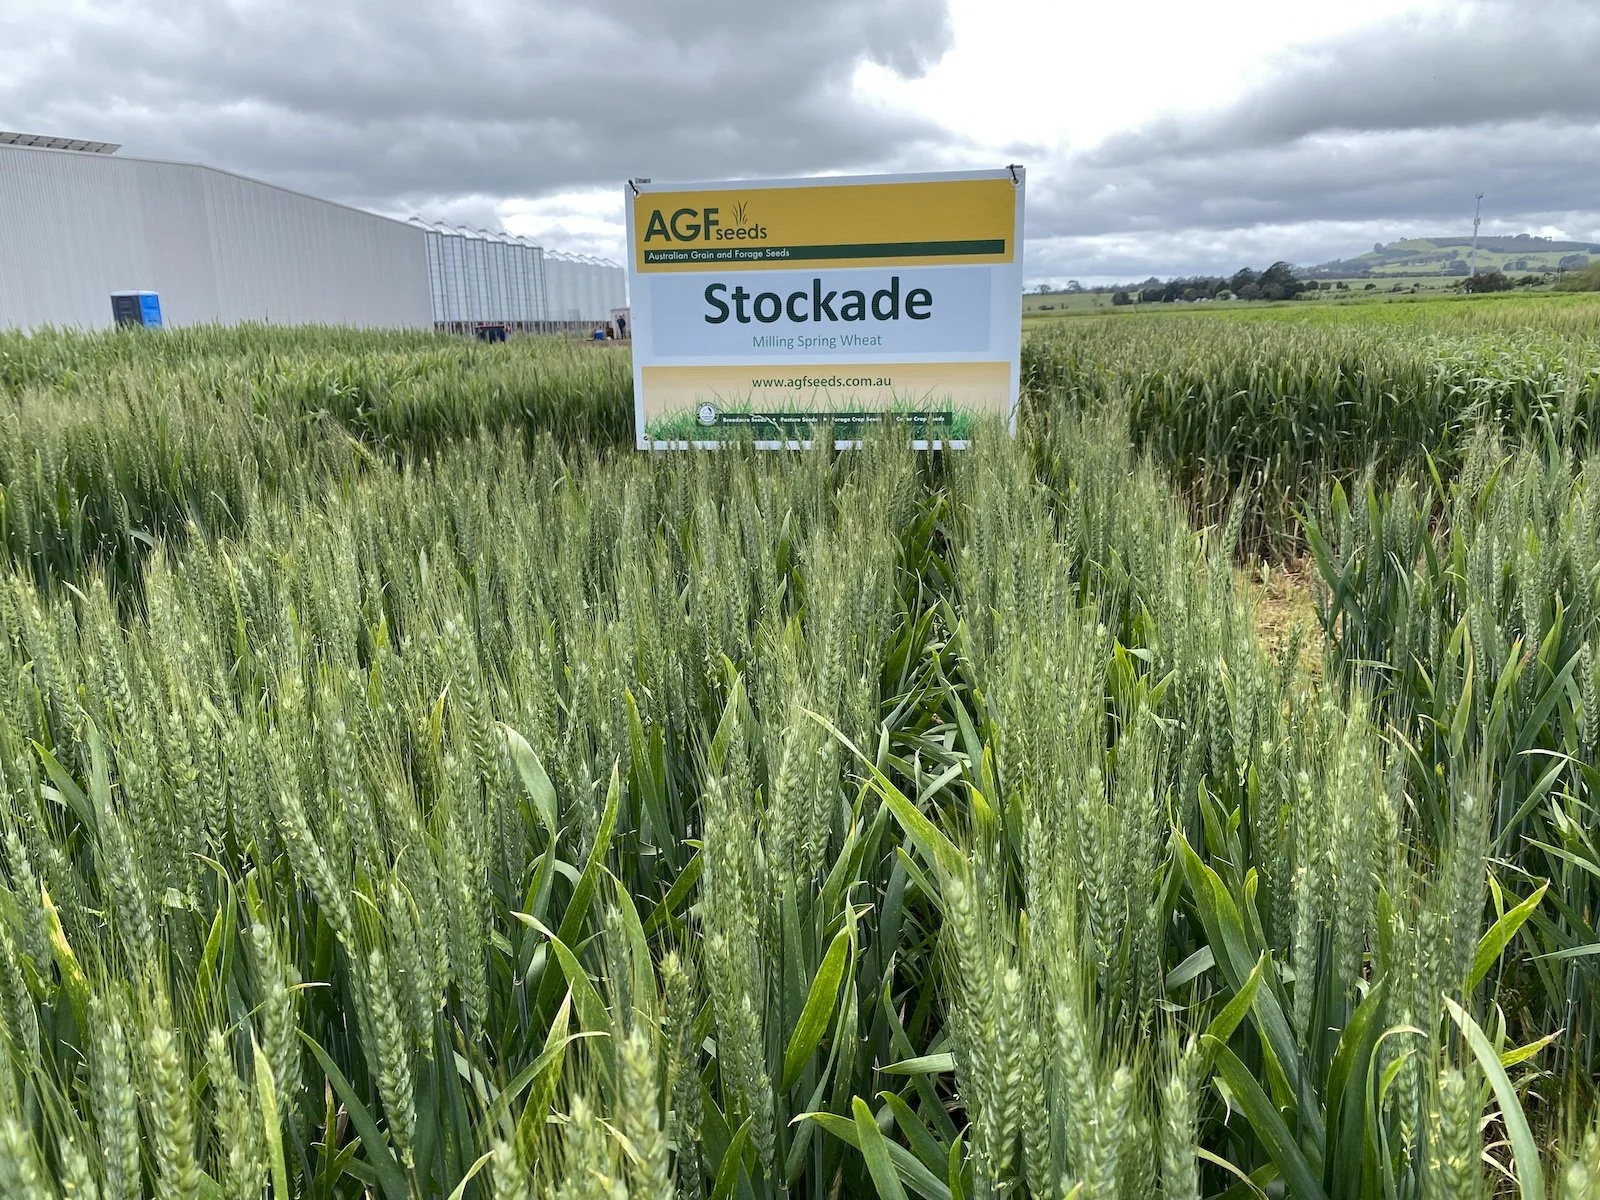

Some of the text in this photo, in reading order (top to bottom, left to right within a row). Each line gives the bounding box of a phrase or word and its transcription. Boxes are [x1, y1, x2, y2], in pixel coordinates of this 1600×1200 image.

[648, 248, 790, 260] Australian Grain and Forage Seeds
[704, 276, 933, 324] Stockade
[752, 334, 882, 350] Milling Spring Wheat
[752, 376, 892, 390] www.agfseeds.com.au
